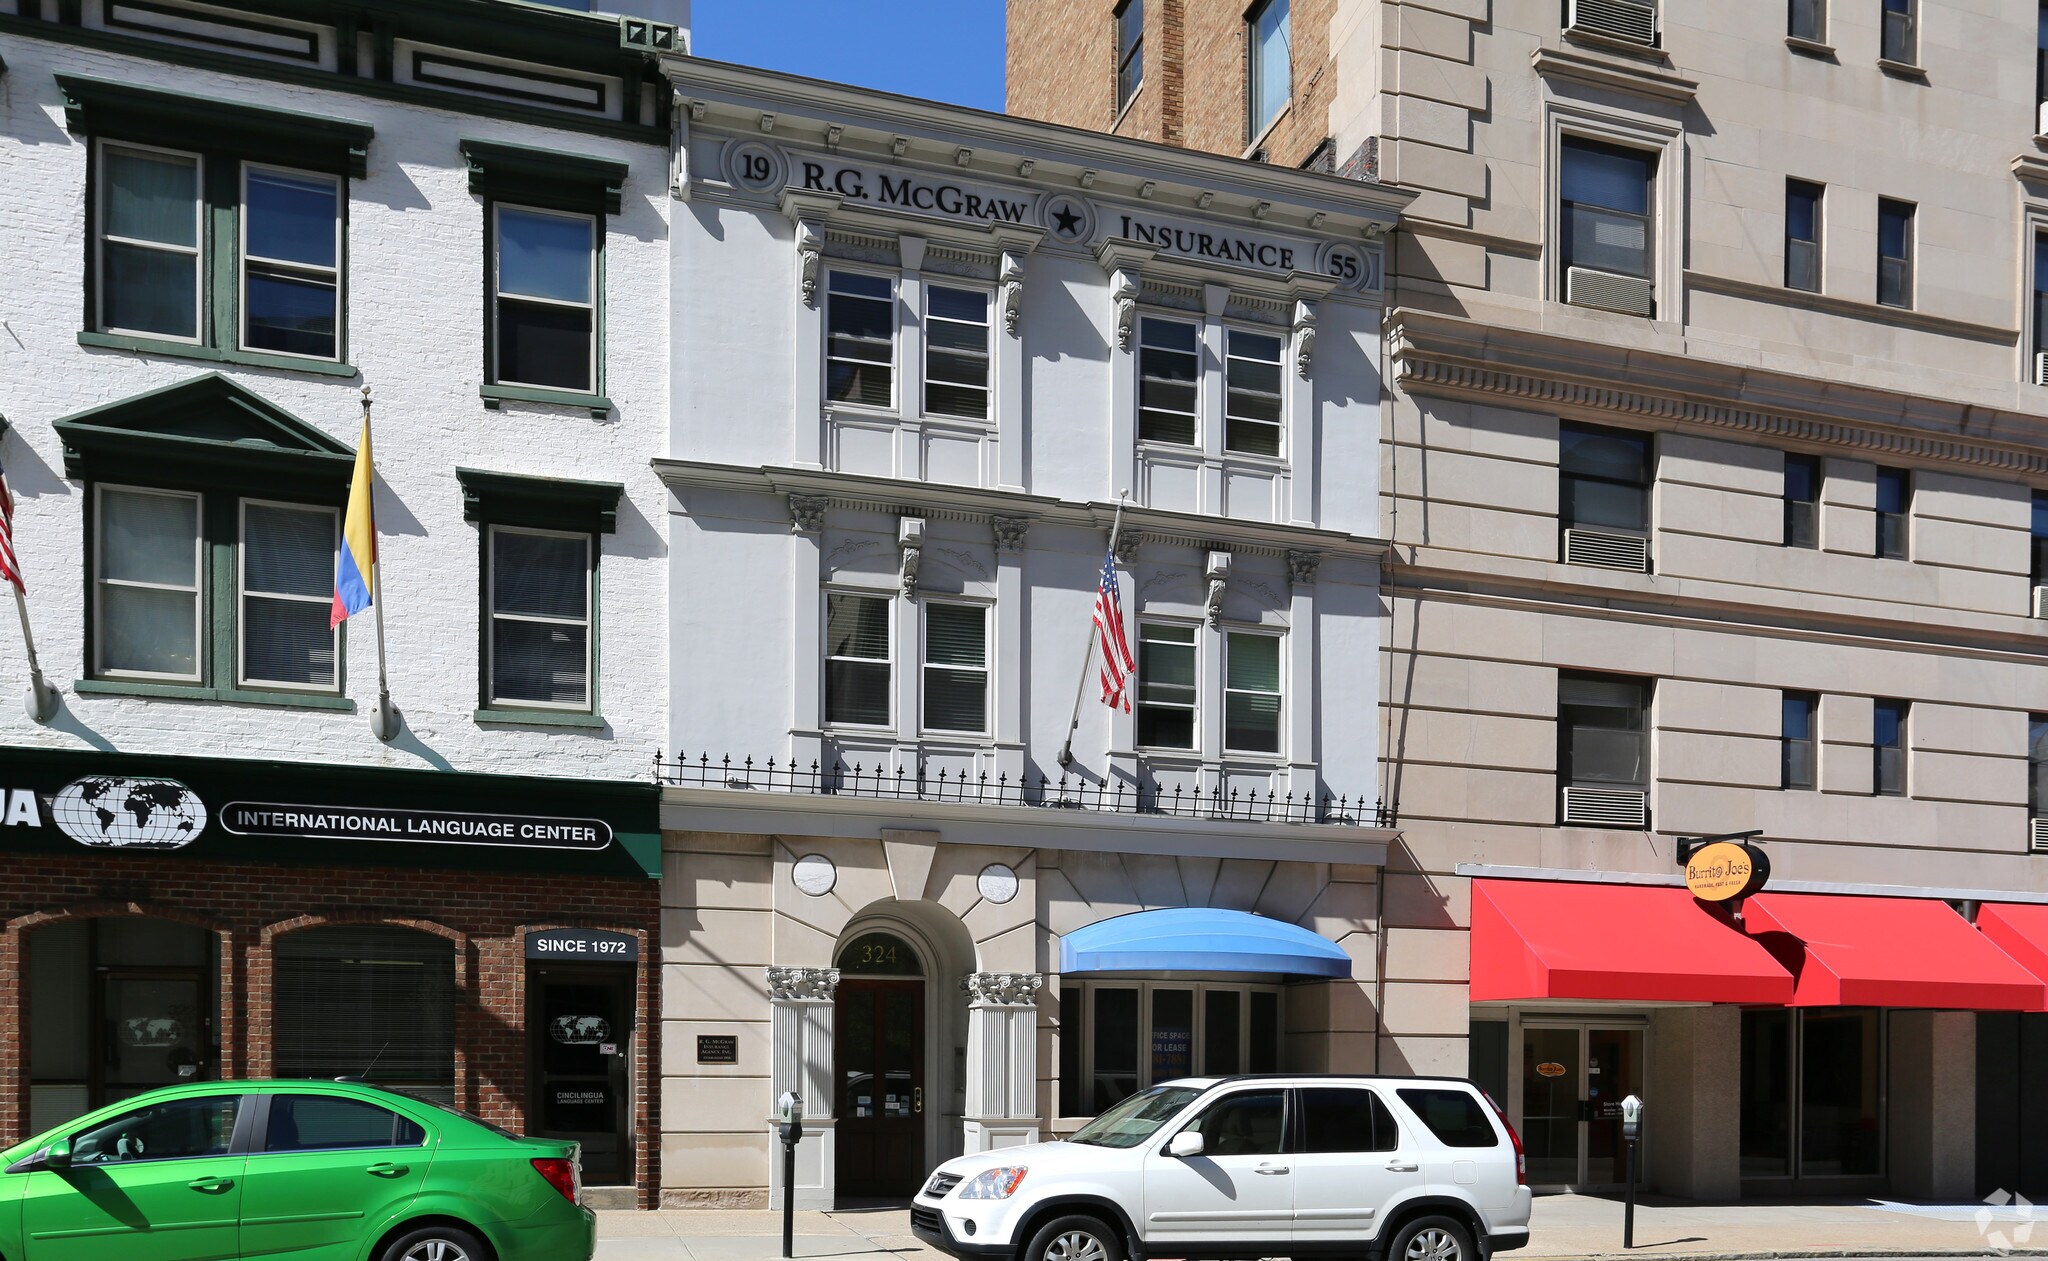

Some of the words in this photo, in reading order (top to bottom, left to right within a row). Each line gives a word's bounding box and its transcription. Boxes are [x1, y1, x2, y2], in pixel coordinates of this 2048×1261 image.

[743, 154, 770, 181] 19
[803, 162, 869, 199] R.G.
[1120, 216, 1295, 270] INSURANCE
[1330, 254, 1357, 279] 55
[237, 810, 402, 832] INTERNATIONAL
[407, 818, 514, 838] LANGUAGE
[520, 823, 597, 841] CENTER
[1688, 866, 1723, 880] Burrito
[1725, 860, 1750, 876] Joe's
[537, 939, 587, 953] SINCE
[591, 941, 627, 954] 1972
[862, 944, 897, 964] 324
[1169, 1031, 1191, 1039] SPACE
[1152, 1043, 1162, 1052] OR
[1164, 1043, 1188, 1052] LEASE
